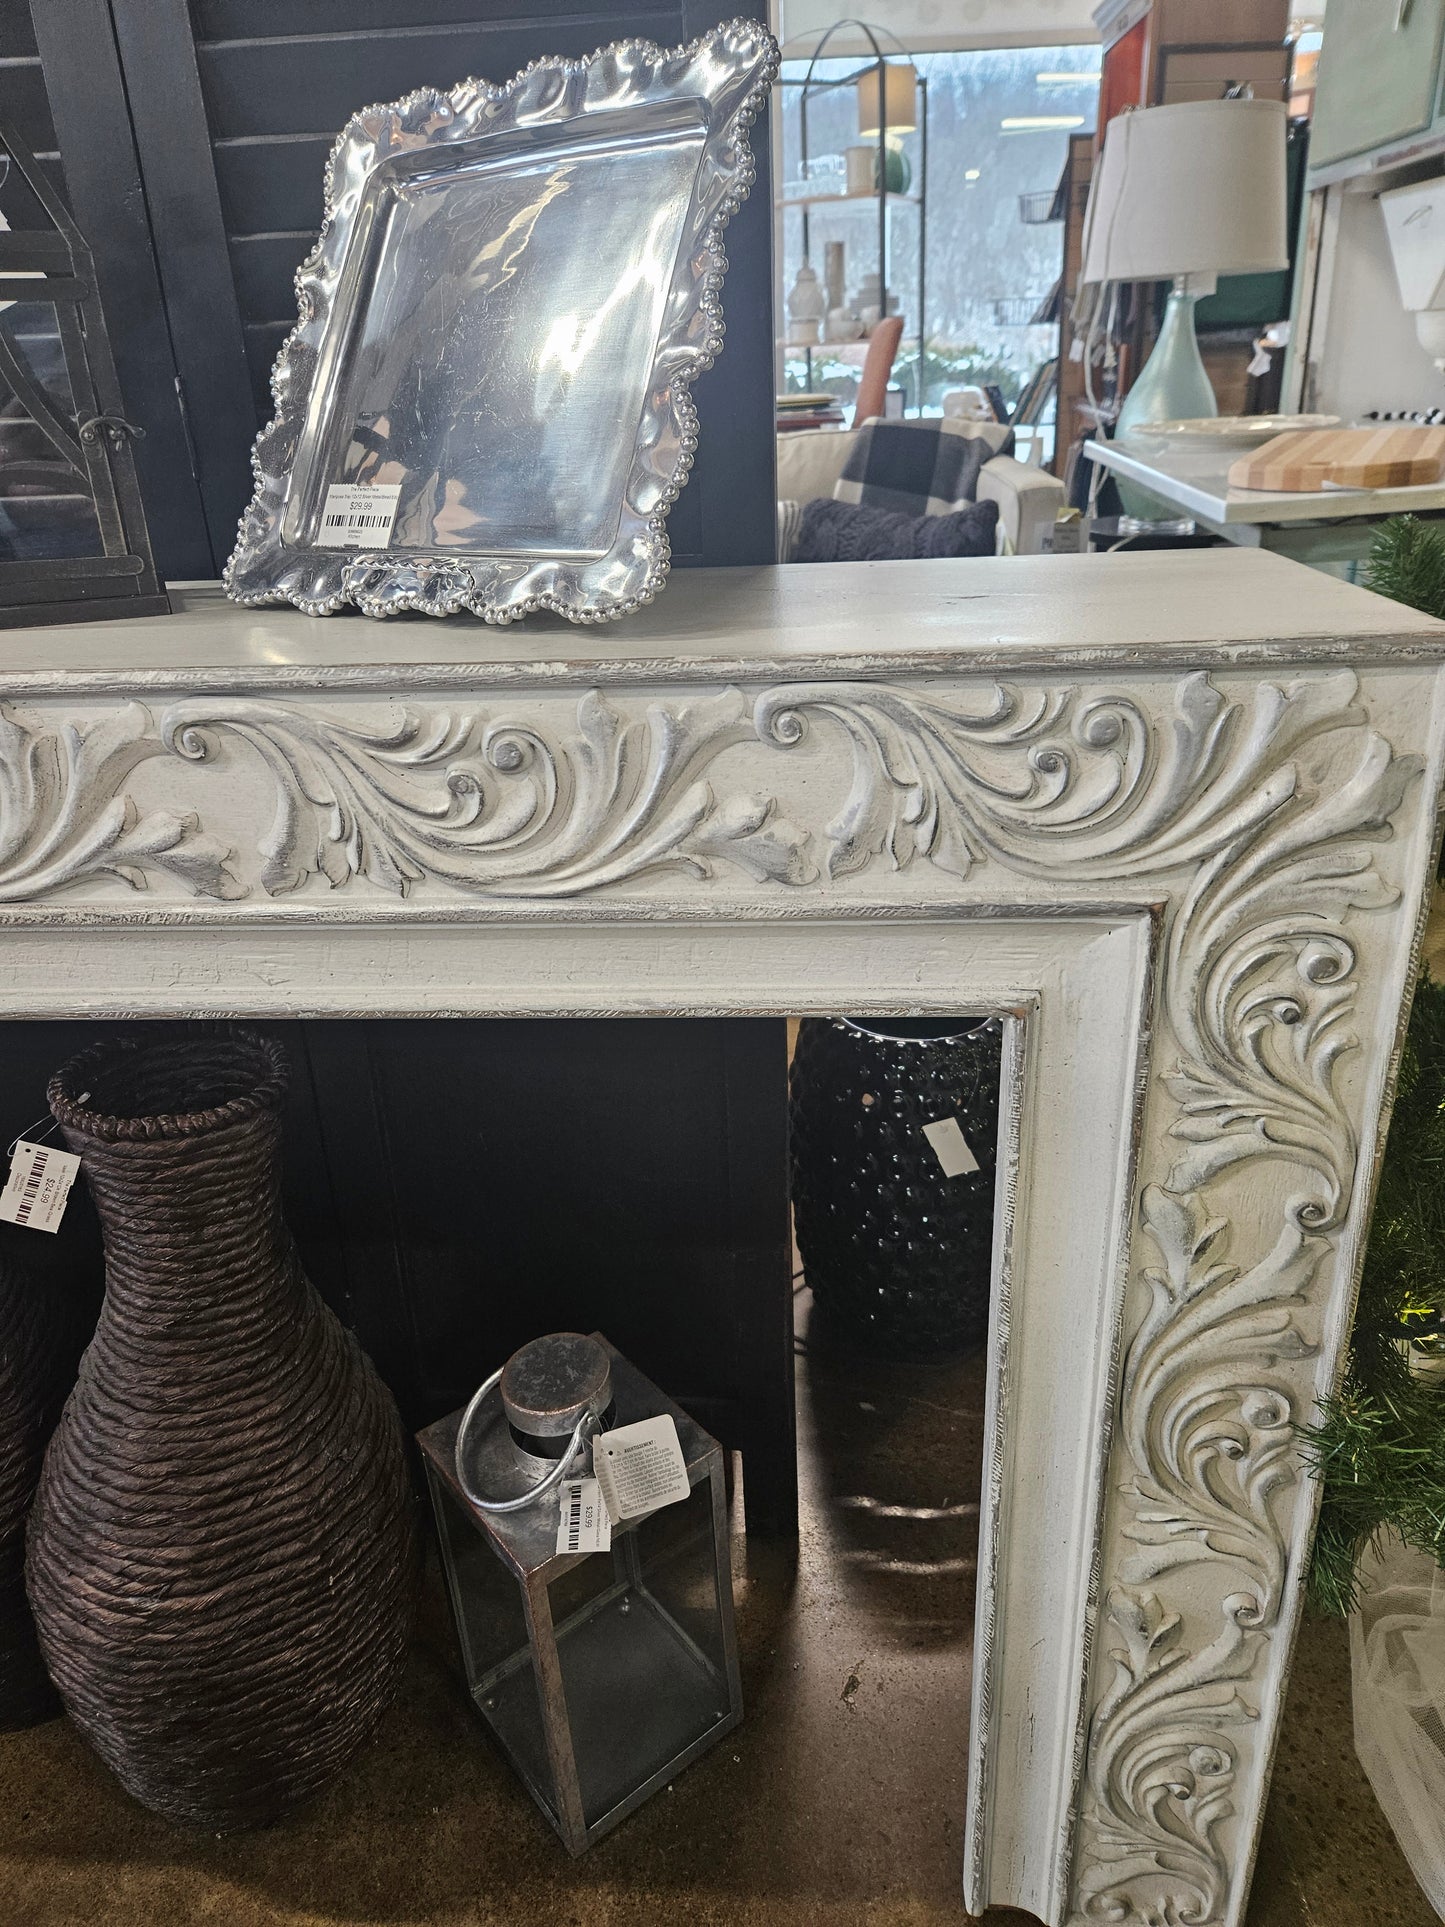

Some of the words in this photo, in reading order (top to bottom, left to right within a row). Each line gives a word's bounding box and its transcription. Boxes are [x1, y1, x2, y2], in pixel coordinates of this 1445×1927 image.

[350, 502, 372, 510] $29.99
[41, 1178, 56, 1205] $24.99
[584, 1505, 593, 1527] $29.99
